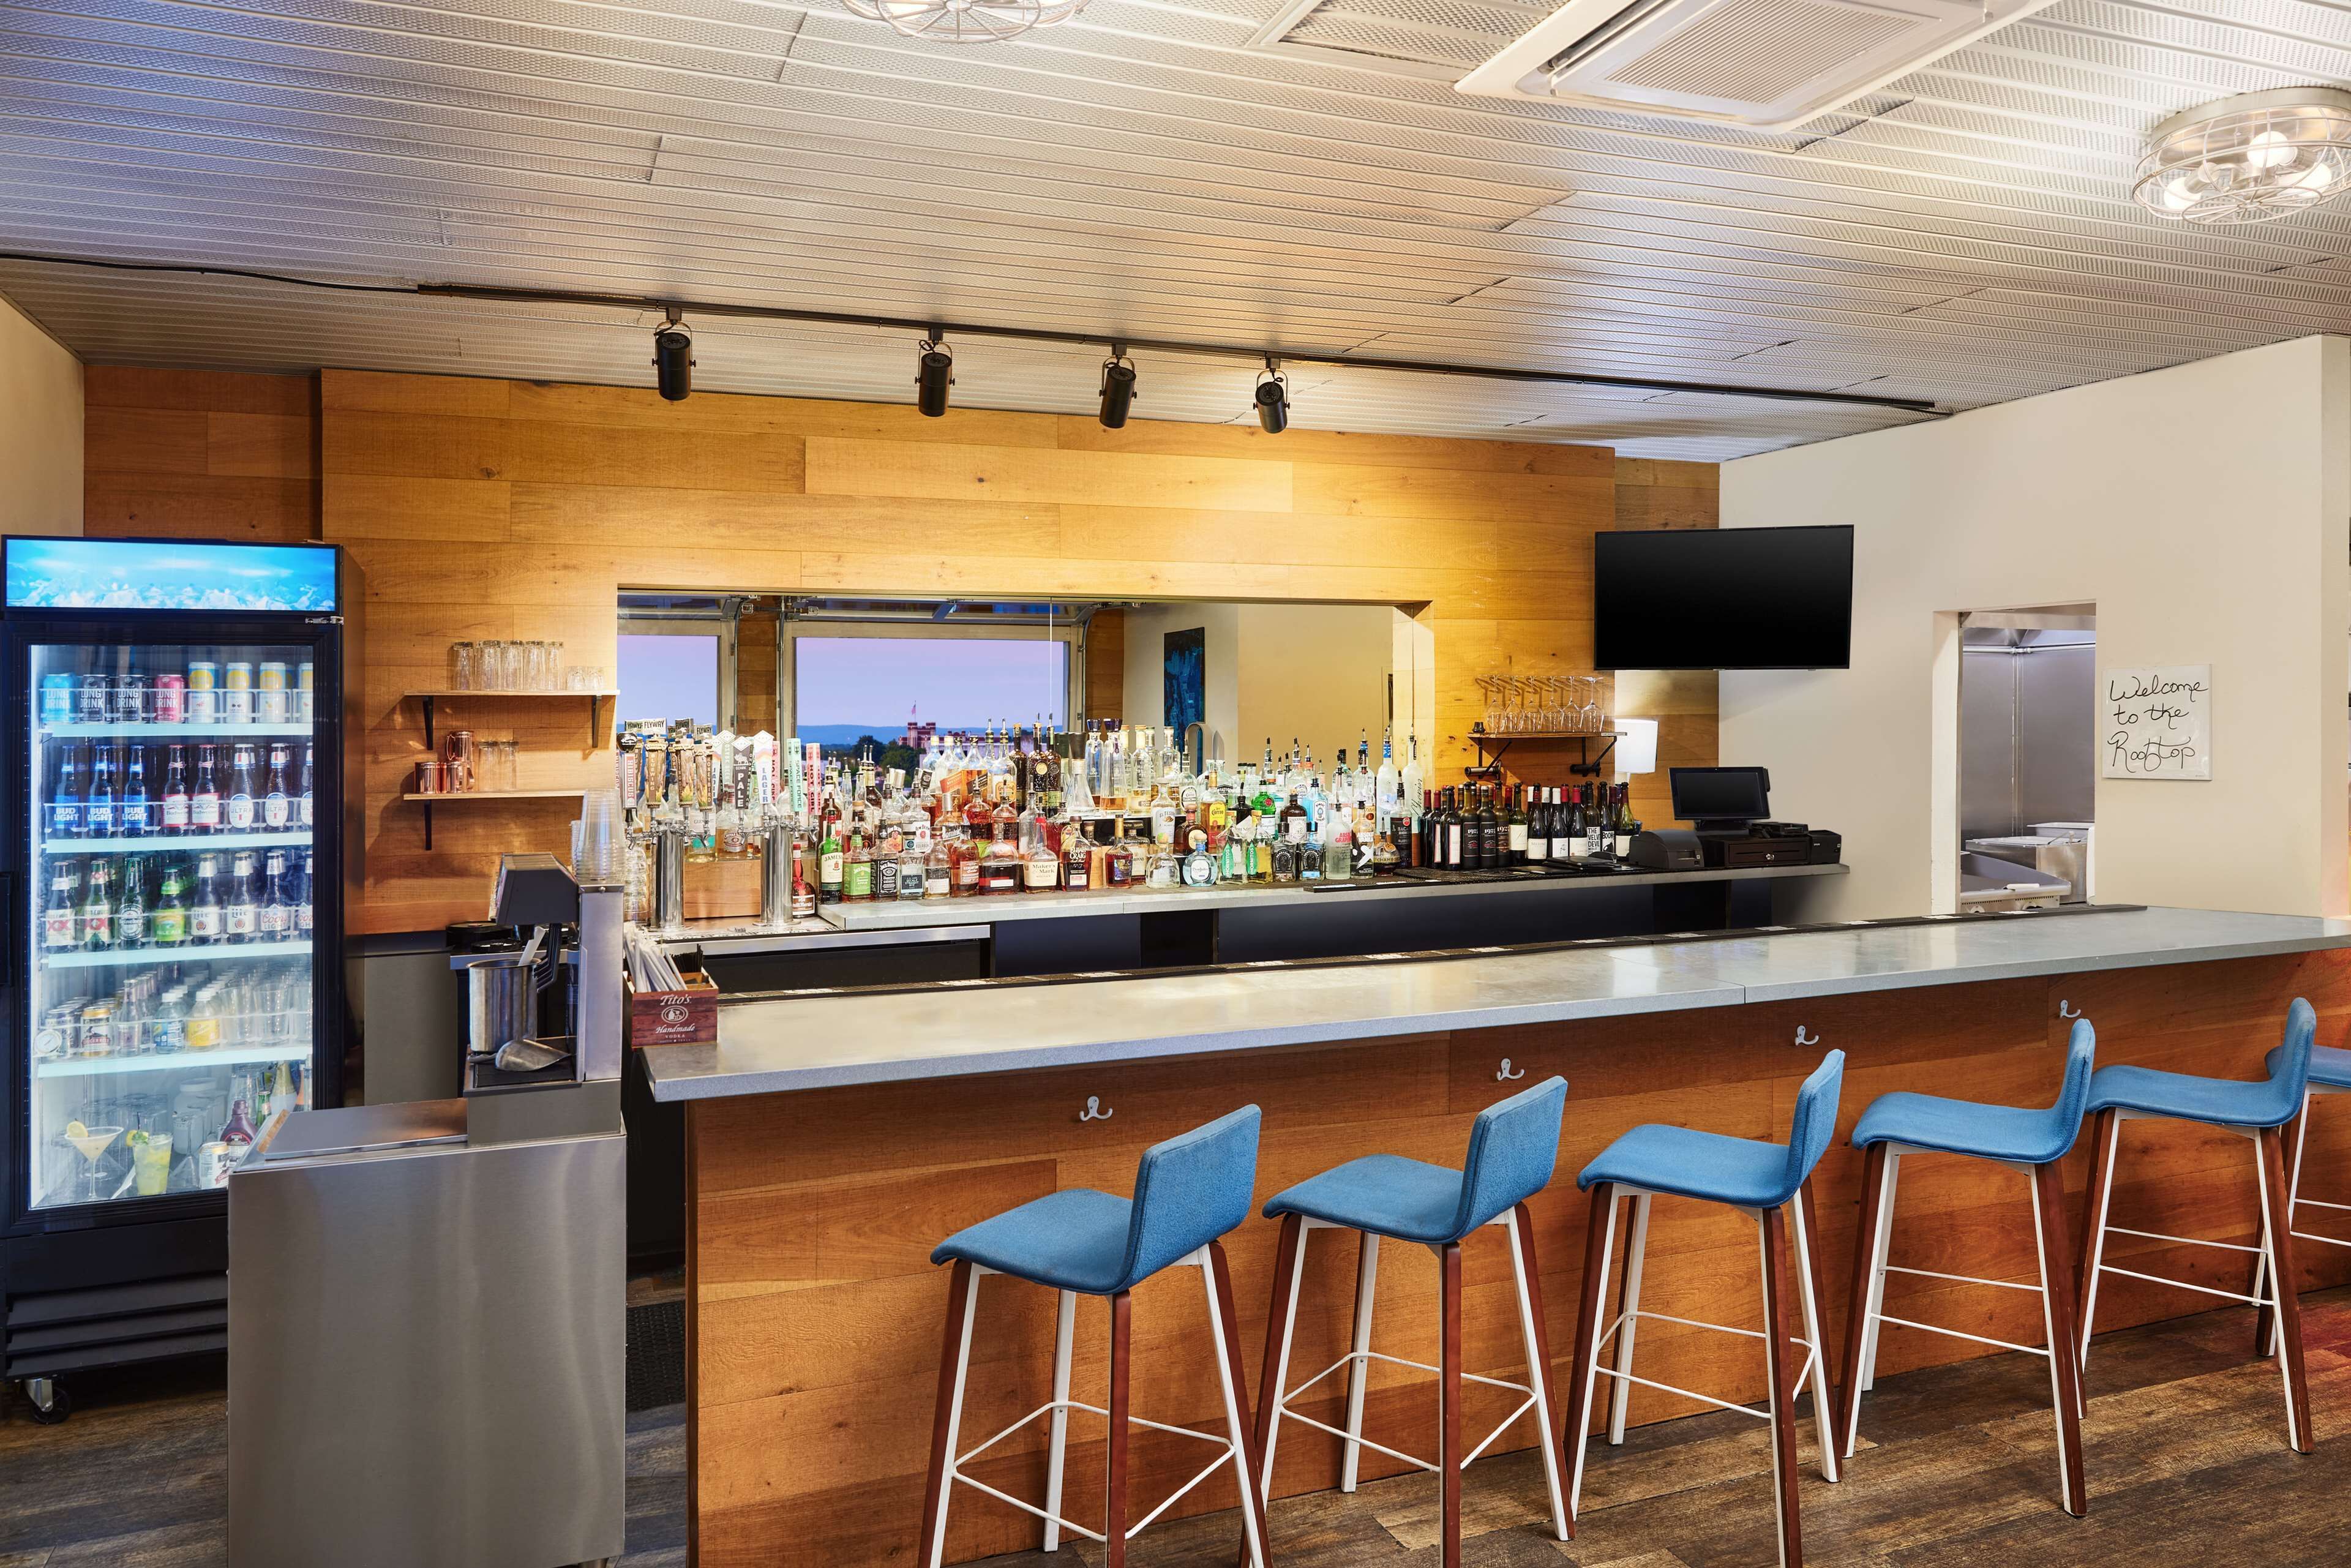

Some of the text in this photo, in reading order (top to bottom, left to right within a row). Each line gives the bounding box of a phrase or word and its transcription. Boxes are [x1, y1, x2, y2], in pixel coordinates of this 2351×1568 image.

[81, 689, 102, 698] LONG
[118, 689, 138, 698] LONG
[156, 689, 176, 698] LONG
[2110, 675, 2209, 703] Welcome
[80, 699, 103, 708] DRINK
[117, 699, 140, 708] DRINK
[155, 699, 178, 708] DRINK
[2113, 703, 2189, 730] to the
[644, 720, 664, 729] FLYWAY
[2107, 731, 2195, 773] Rooftop
[660, 994, 691, 1005] Tito's
[656, 1023, 696, 1033] Handmade
